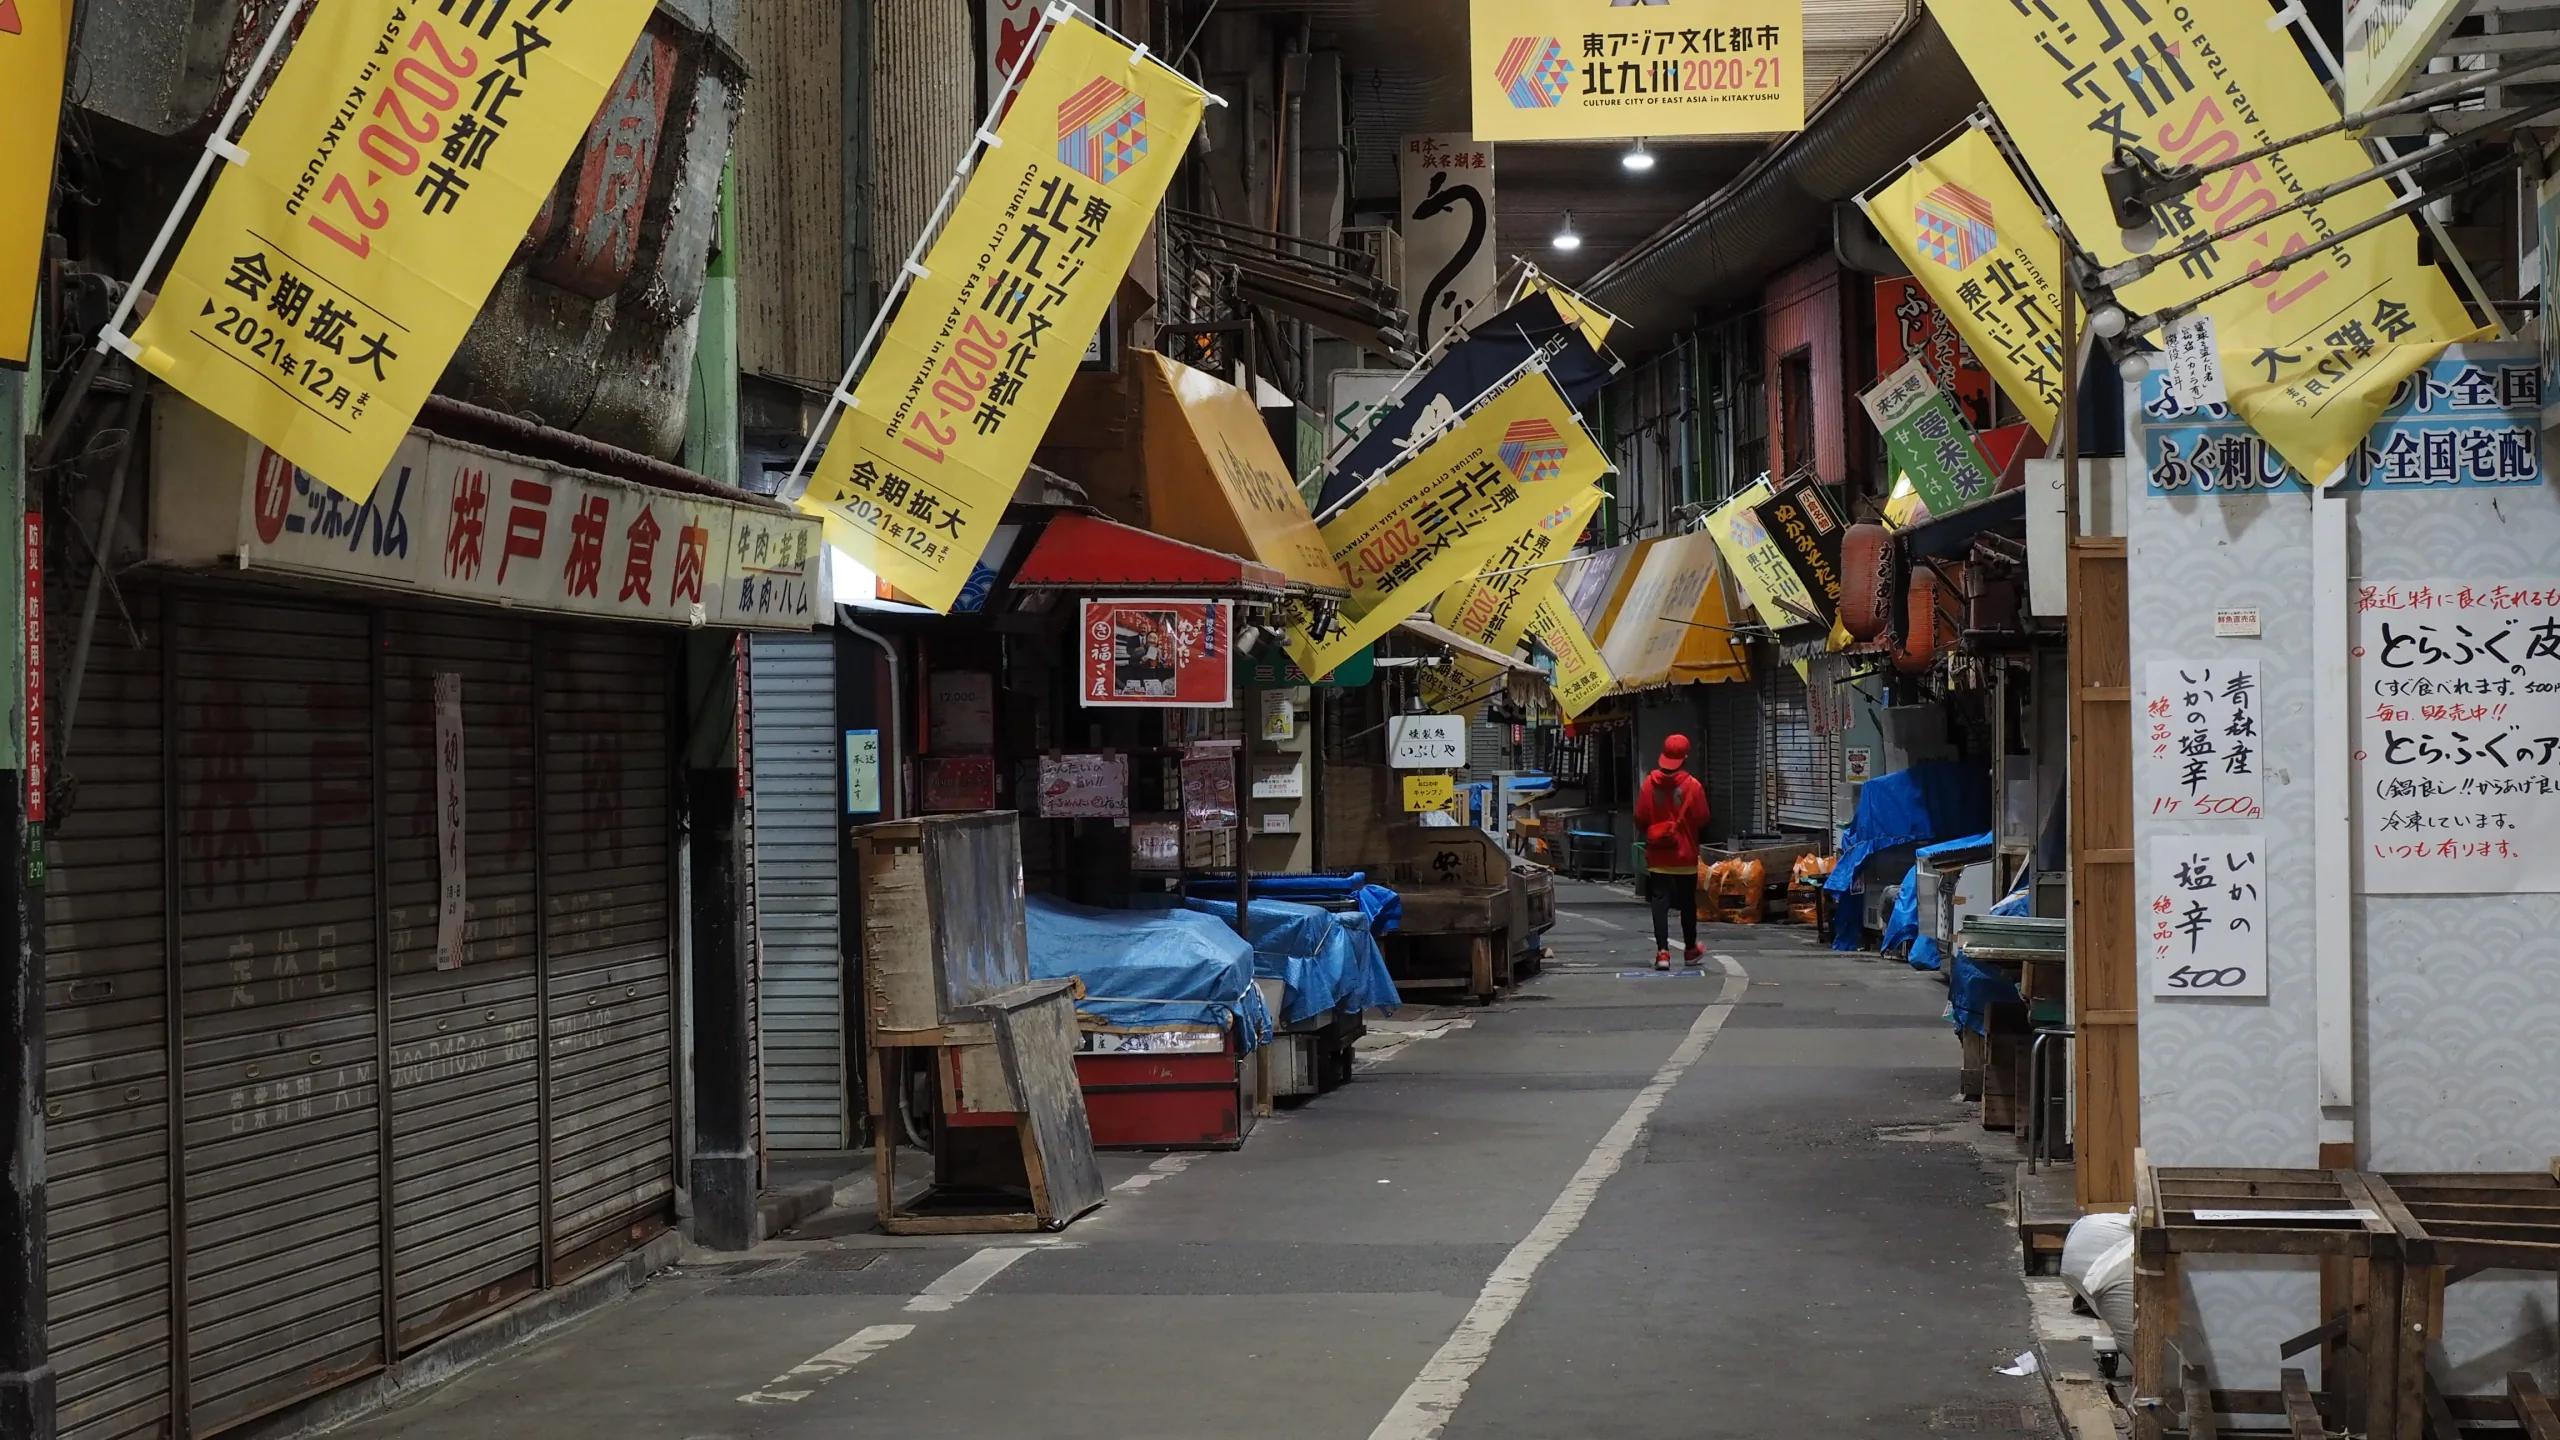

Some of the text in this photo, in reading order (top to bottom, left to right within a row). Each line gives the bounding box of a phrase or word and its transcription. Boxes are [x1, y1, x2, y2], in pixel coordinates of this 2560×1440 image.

[1582, 24, 1780, 58] 東アジア文化都市
[286, 11, 408, 216] ASIA in KITAKYUSHU
[1583, 93, 1780, 107] CULTURE CITY OF EAST ASIA in KITAKYUSHU
[1409, 137, 1449, 154] 日本一
[1422, 152, 1486, 169] 浜名湖産
[224, 251, 398, 382] 会期拡大
[885, 163, 1038, 438] CULTURE CITY OF EAST ASIA in KITAKYUSHU
[972, 195, 1112, 436] 東アジア文化都市
[1431, 472, 1449, 489] CITY
[1450, 447, 1483, 474] CULTURE
[849, 460, 967, 540] 会期拡大
[1400, 495, 1419, 512] EAST
[1420, 486, 1431, 497] OF
[1800, 492, 1830, 531] 小倉名物
[1378, 509, 1398, 526] ASIA
[1376, 483, 1520, 594] 東アジア文化都市
[1774, 504, 1842, 612] ぬかみそだき
[28, 523, 42, 812] 防災・防犯用カメラ作動中
[1435, 661, 1476, 694] 期拡大
[2179, 669, 2216, 798] いかの塩辛
[2221, 671, 2257, 775] 青森産
[1400, 744, 1456, 758] いぶしや
[2384, 725, 2560, 768] とらふぐのア
[2173, 852, 2217, 956] 塩辛
[2227, 851, 2257, 934] いかの
[2168, 965, 2247, 988] 500
